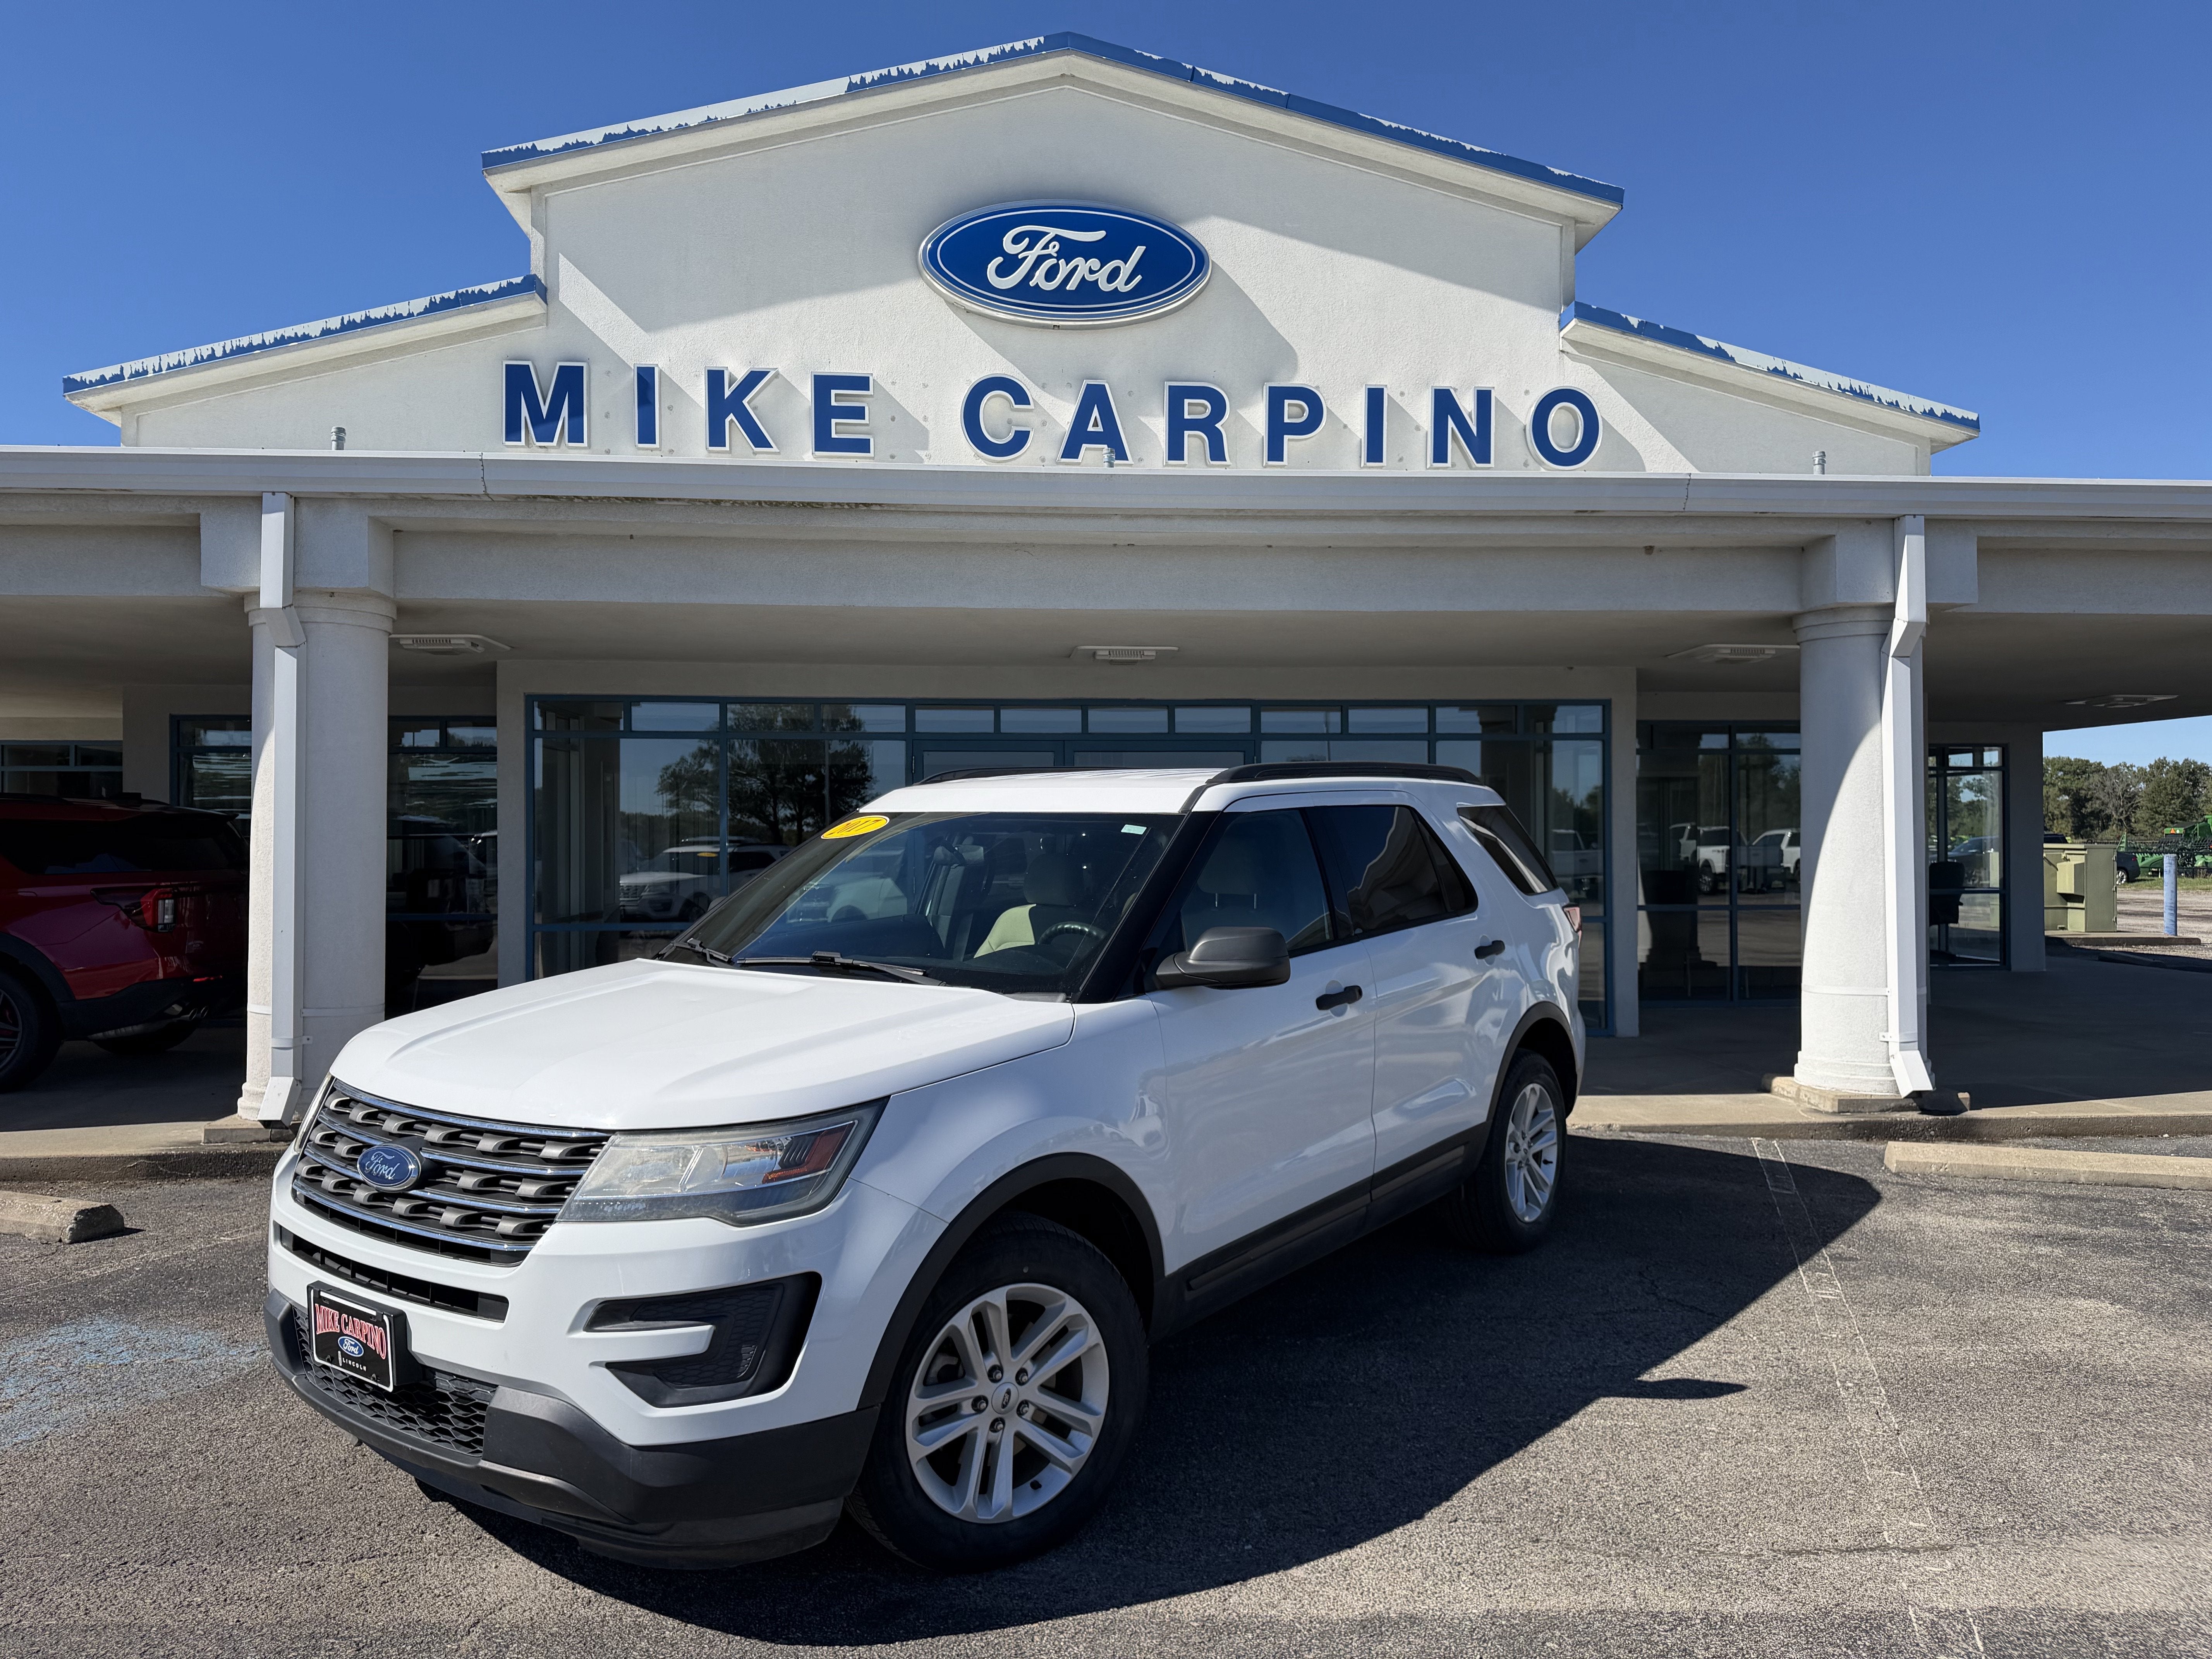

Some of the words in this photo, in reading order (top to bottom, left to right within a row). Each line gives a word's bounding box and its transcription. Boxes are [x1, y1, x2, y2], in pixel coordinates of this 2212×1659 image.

[987, 225, 1146, 292] Ford
[502, 360, 874, 458] MIKE
[960, 373, 1604, 470] CARPINO
[826, 819, 883, 836] 2017
[364, 1151, 400, 1180] Ford
[315, 1304, 340, 1335] MIKE
[341, 1314, 386, 1359] CARPINO
[343, 1339, 359, 1354] Ford
[342, 1357, 366, 1372] LINCOLN
